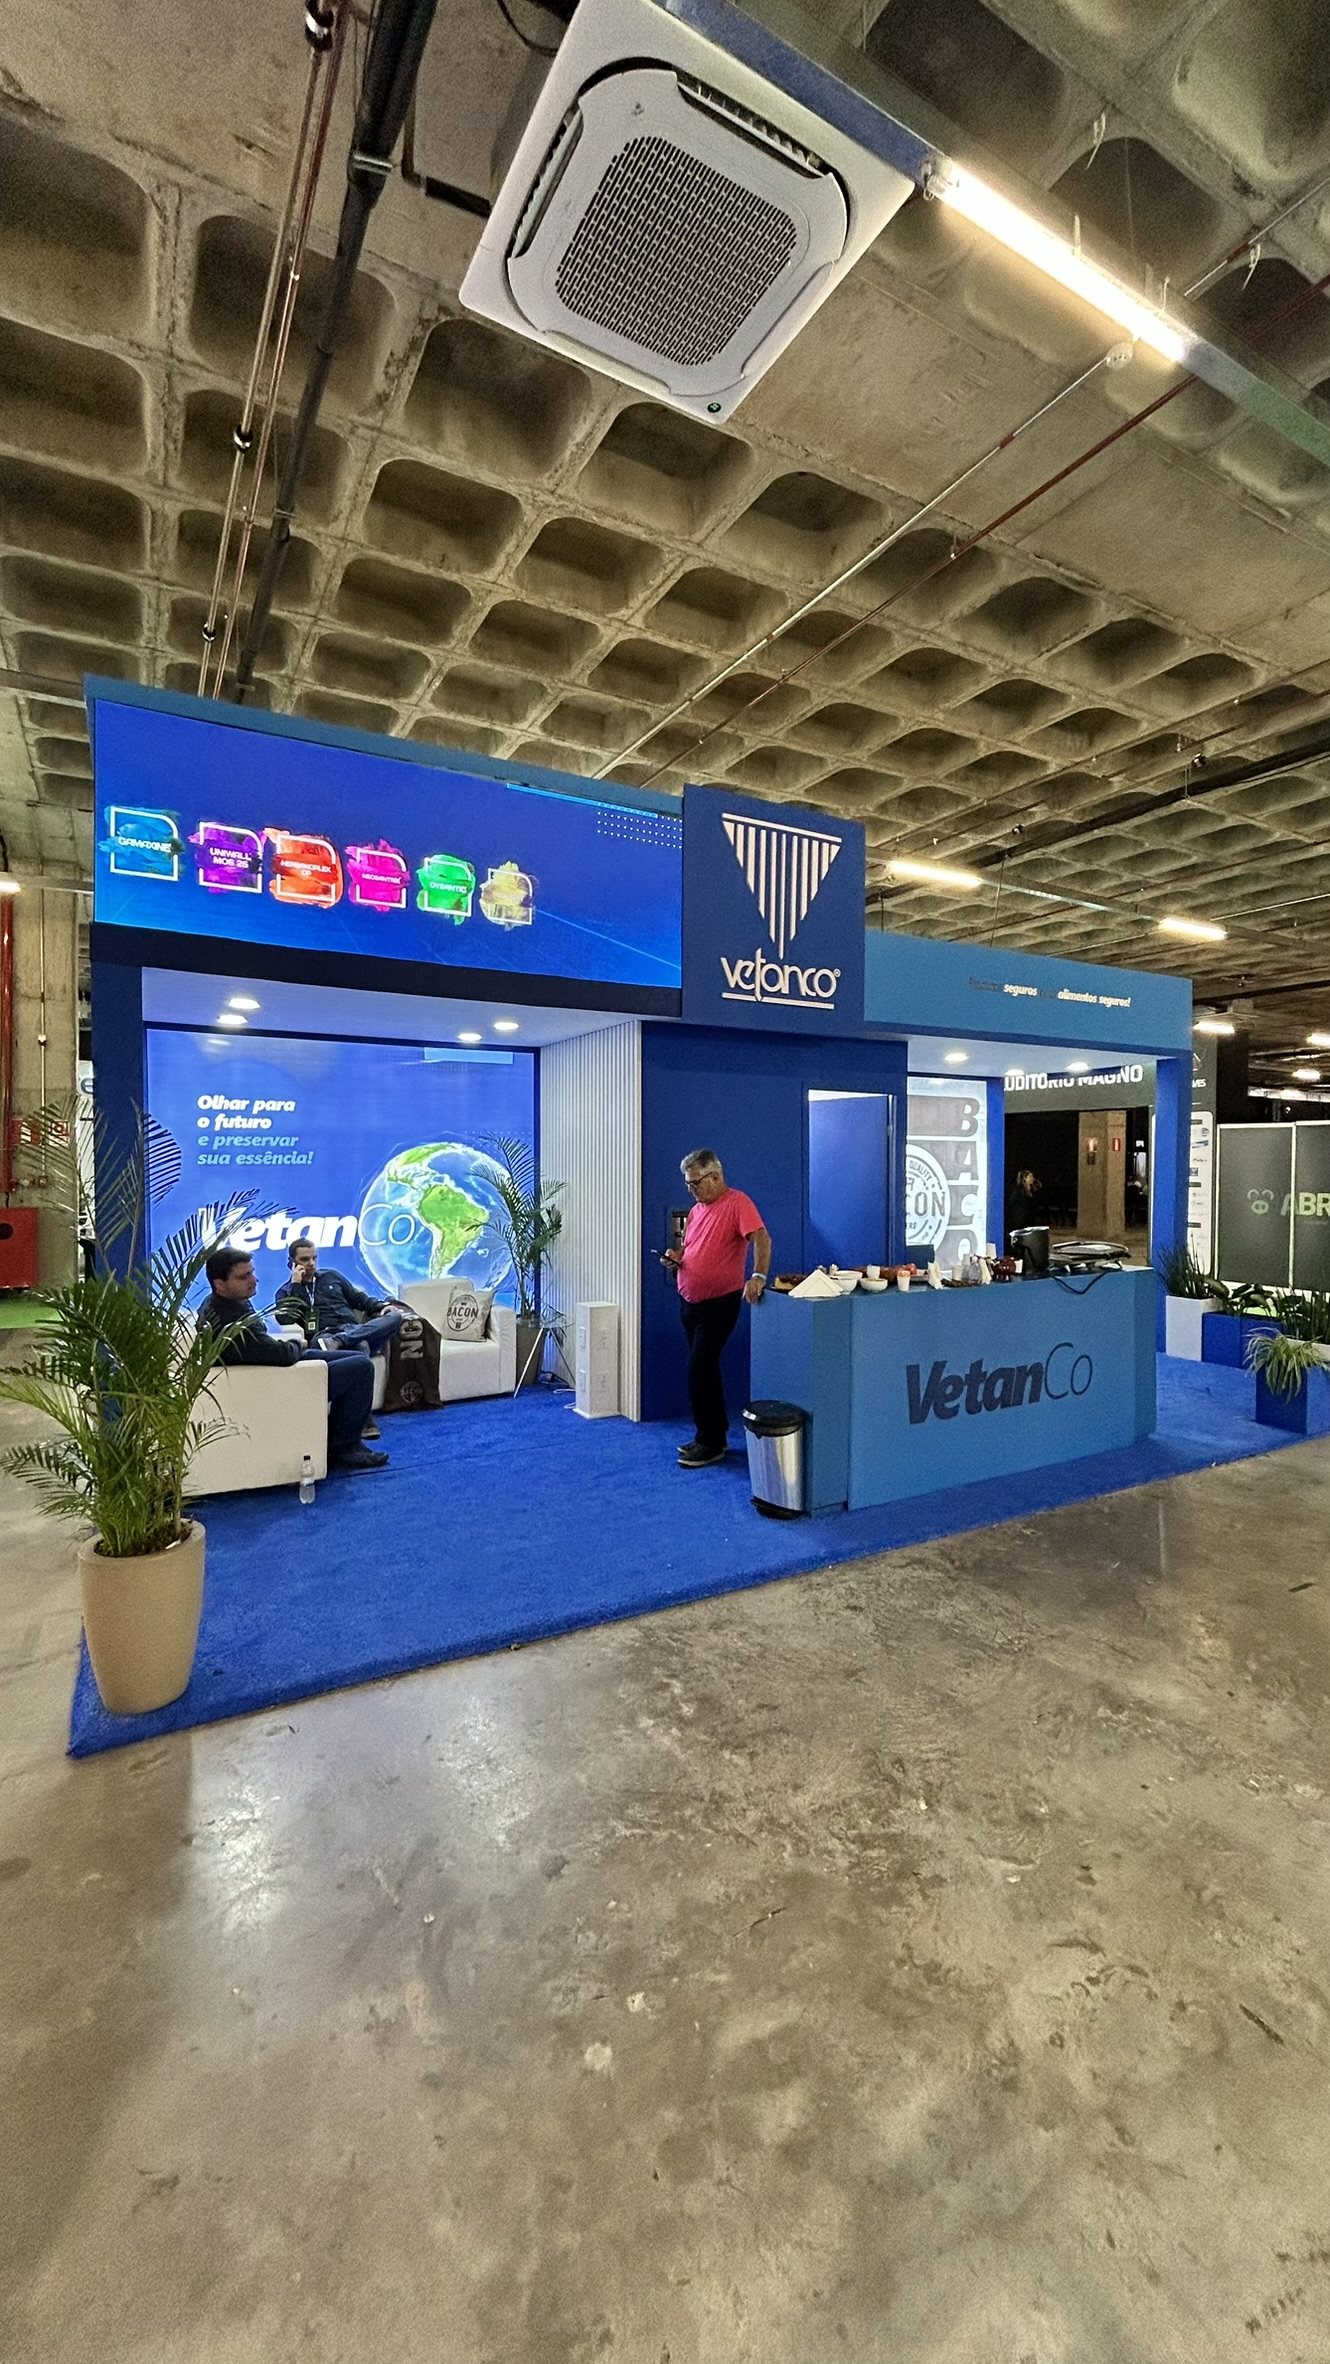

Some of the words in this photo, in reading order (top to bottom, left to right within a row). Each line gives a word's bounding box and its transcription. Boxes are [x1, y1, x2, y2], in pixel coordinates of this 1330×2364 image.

[118, 837, 171, 852] GAMAXINE
[210, 847, 252, 861] UNIWALL
[1003, 983, 1037, 997] seguros
[1058, 988, 1097, 1003] alimentos
[1098, 997, 1131, 1008] seguros!
[197, 1095, 250, 1110] Olhar
[252, 1099, 296, 1114] para
[197, 1117, 210, 1128] o
[214, 1113, 272, 1131] futuro
[198, 1135, 209, 1146] e
[213, 1135, 299, 1150] preservar
[197, 1153, 231, 1165] sua
[236, 1151, 314, 1165] essência!
[909, 1160, 932, 1181] QUALITY
[198, 1203, 415, 1251] VetanCo
[447, 1306, 479, 1319] BACON
[906, 1342, 1093, 1425] VetanCo
